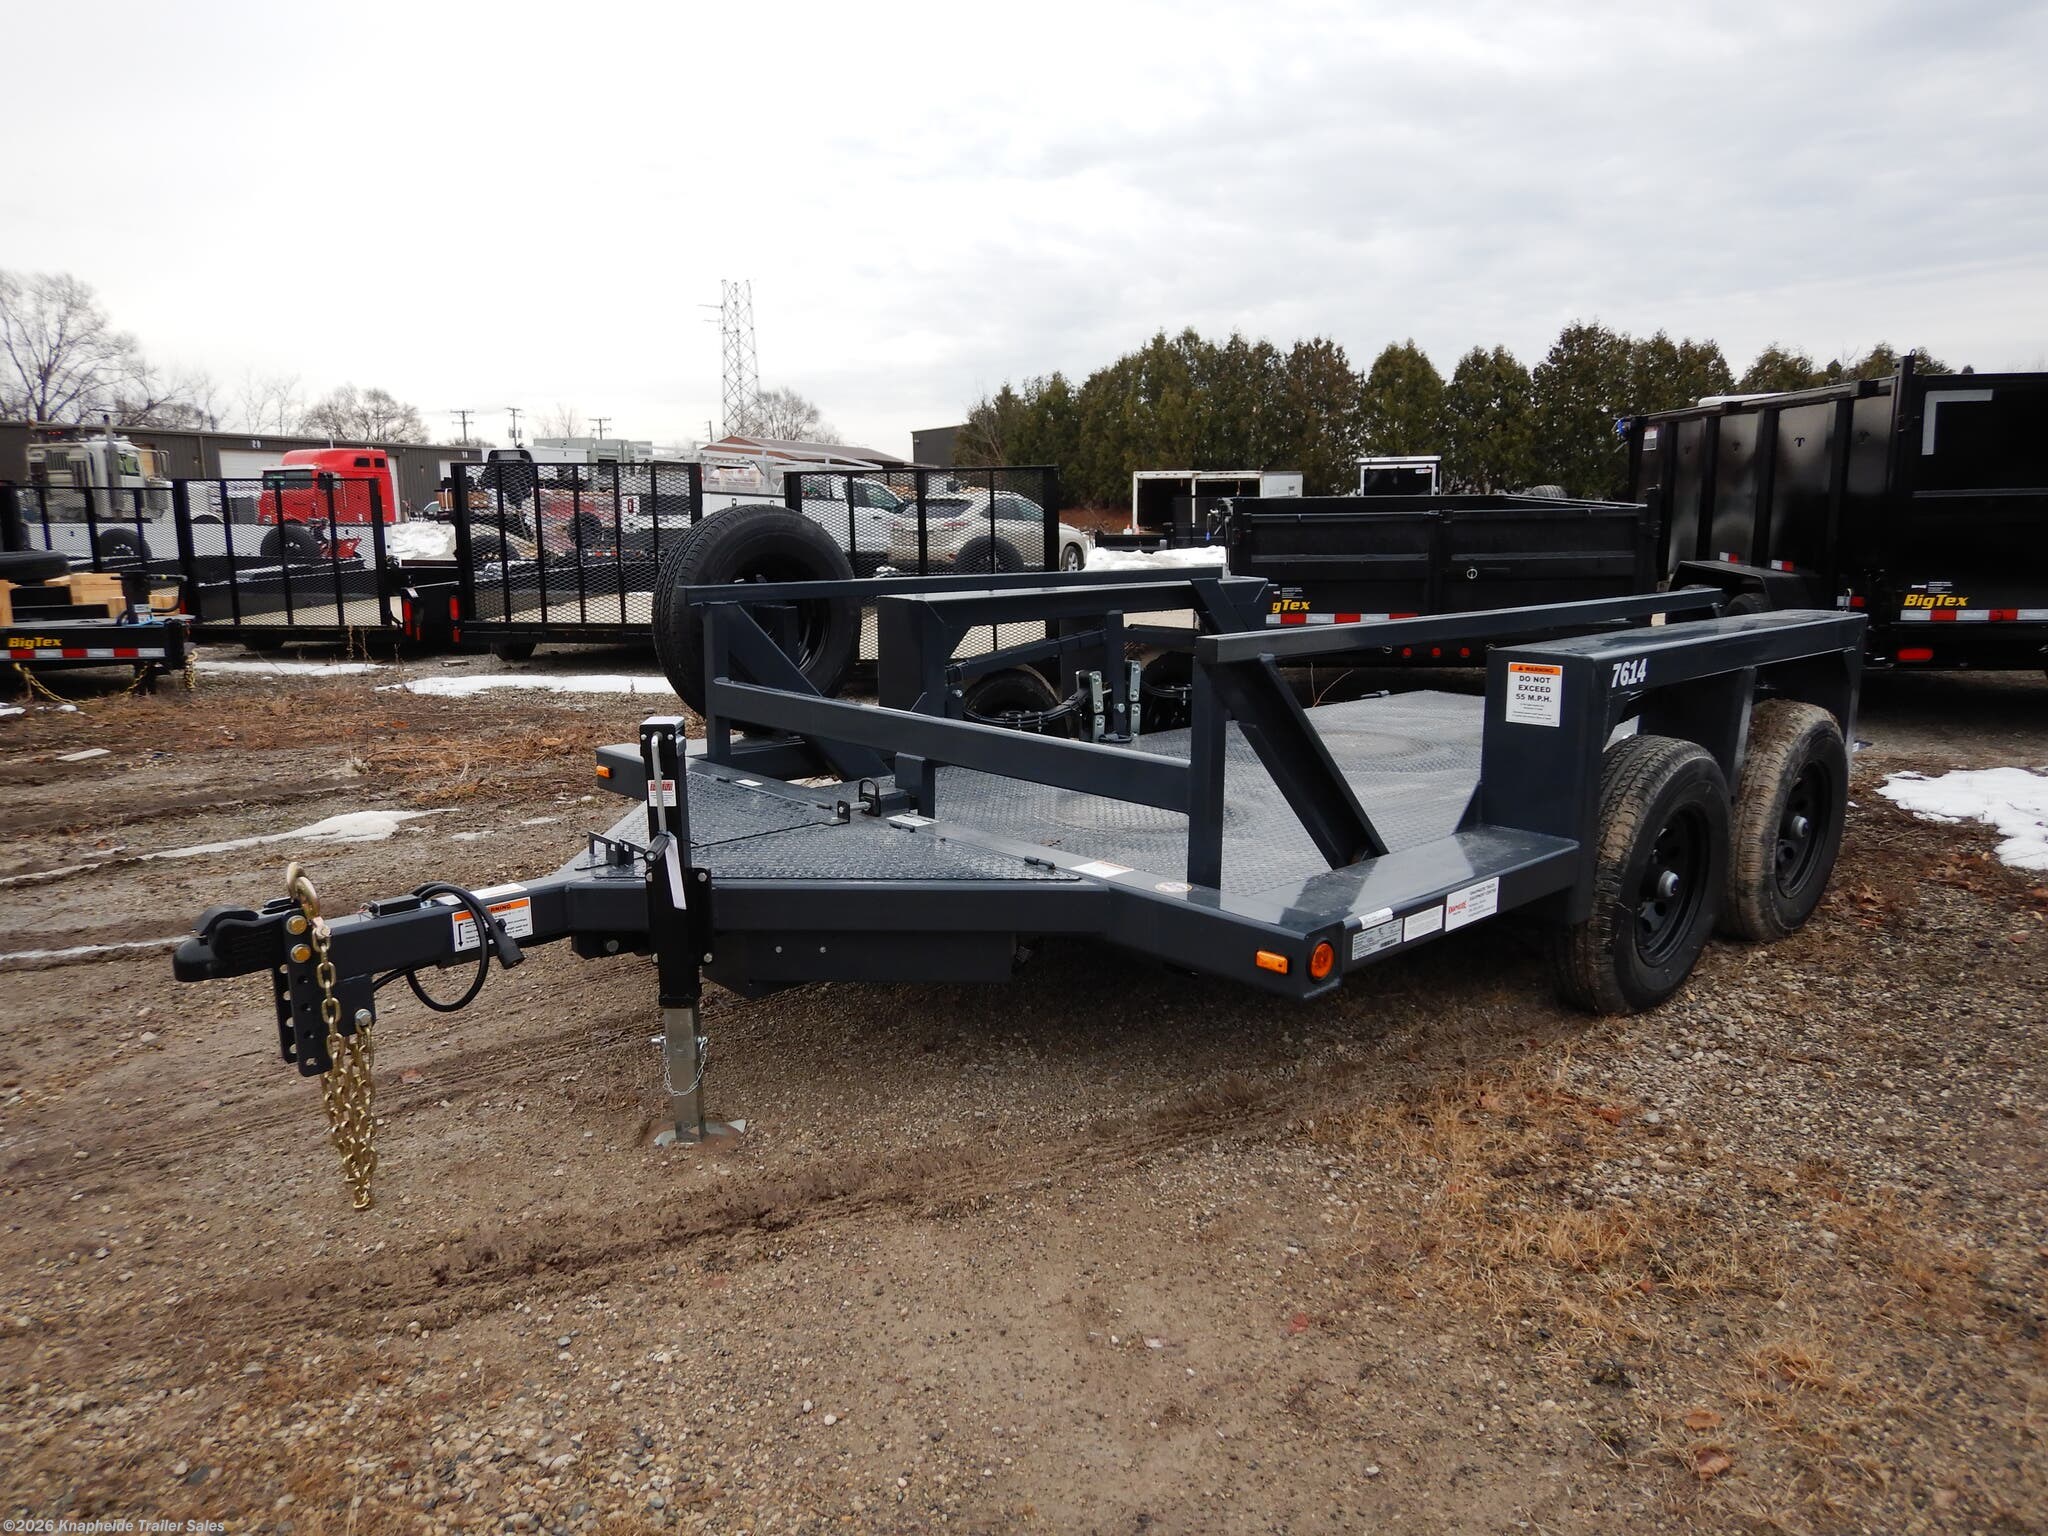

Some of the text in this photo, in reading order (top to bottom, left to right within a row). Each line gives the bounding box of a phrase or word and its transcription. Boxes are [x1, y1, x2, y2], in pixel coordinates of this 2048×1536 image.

[1272, 599, 1311, 614] gTex
[1904, 594, 1968, 610] BigTex
[8, 637, 62, 650] BigTex
[1533, 676, 1551, 684] NOT
[1610, 658, 1648, 689] 7614
[1518, 684, 1551, 693] EXCEED
[1527, 694, 1553, 703] M.P.H.
